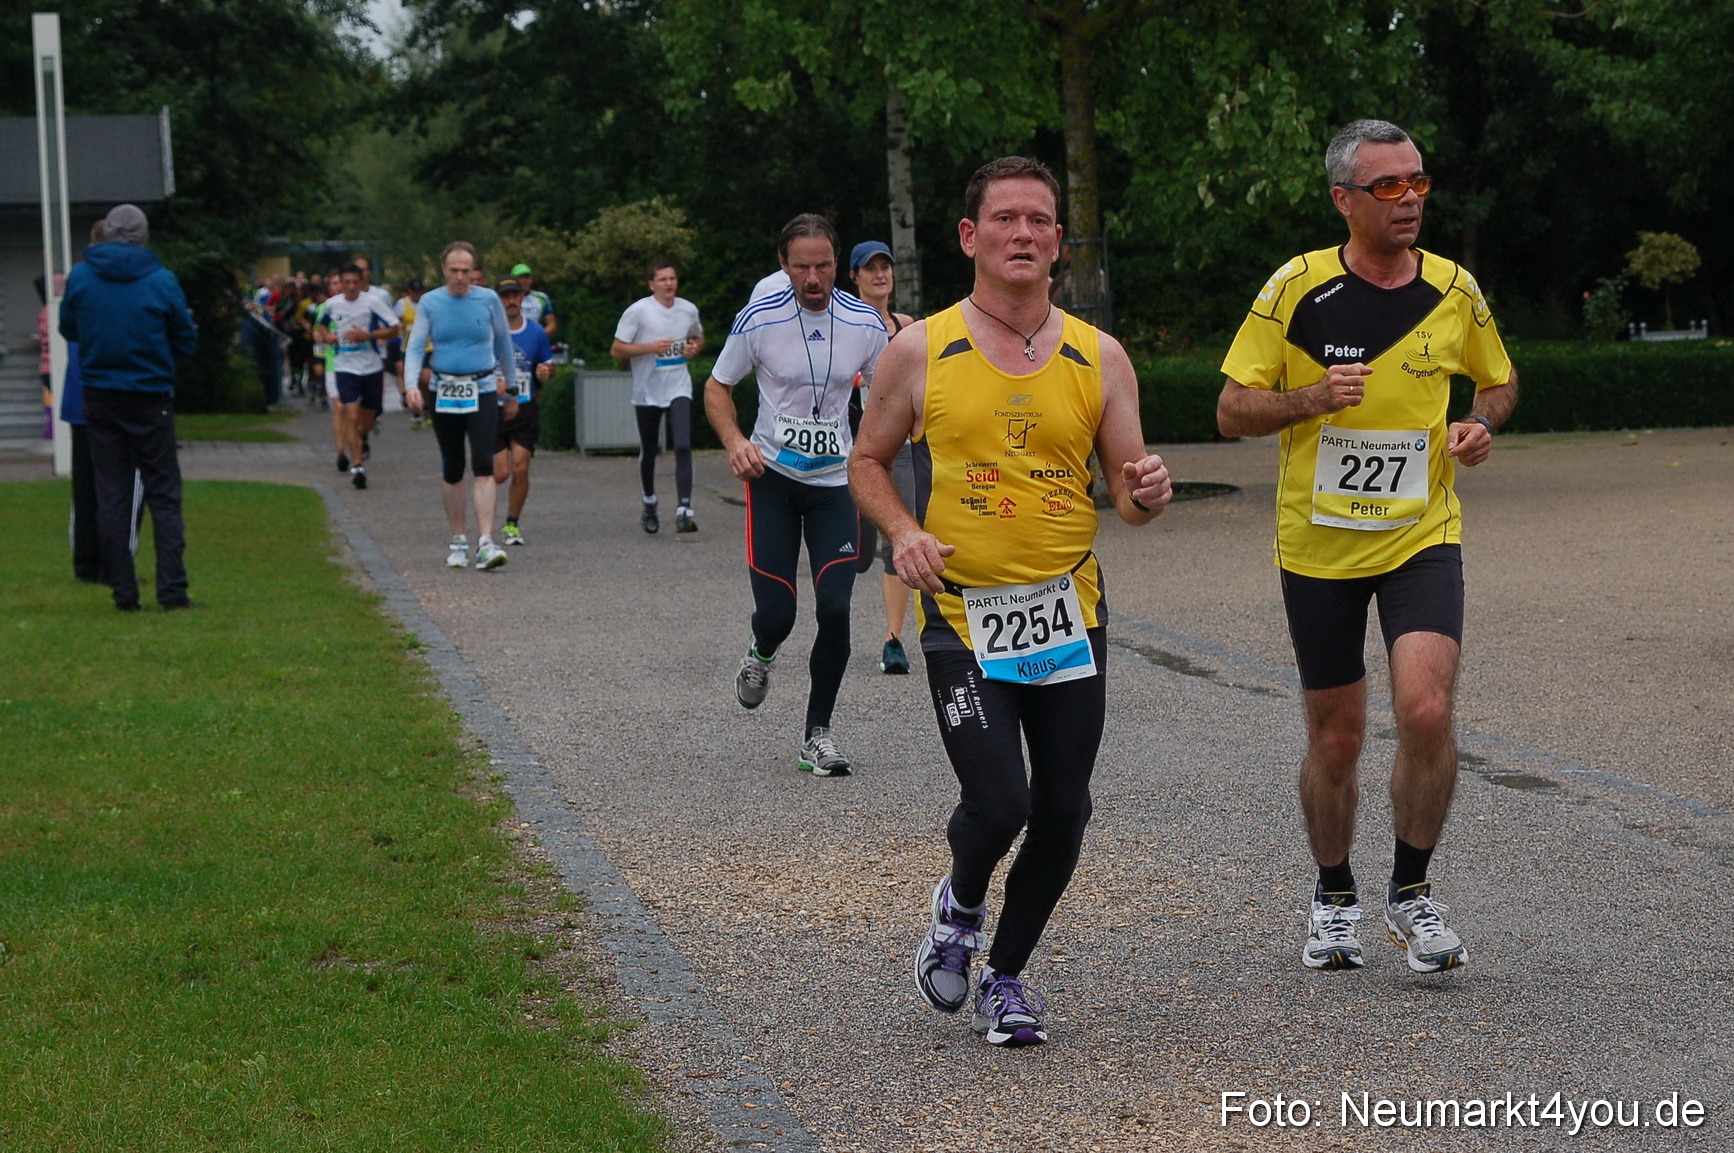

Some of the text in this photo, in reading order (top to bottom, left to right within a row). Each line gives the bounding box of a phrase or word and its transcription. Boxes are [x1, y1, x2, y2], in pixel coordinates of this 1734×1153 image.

[1314, 282, 1344, 304] STANNO
[1415, 331, 1433, 339] TSV
[1324, 344, 1365, 357] Peter
[440, 383, 473, 398] 2225
[778, 416, 801, 426] PARTL
[783, 428, 840, 455] 2988
[1320, 435, 1411, 451] PARTL Neumarkt
[966, 469, 1000, 483] Seidl
[1338, 454, 1407, 493] 227
[1350, 501, 1390, 516] Peter
[967, 583, 1057, 610] PARTL Neumarkt
[982, 597, 1074, 654] 2254
[1016, 658, 1057, 678] Klaus
[954, 687, 971, 715] Run!
[973, 696, 989, 729] Runners
